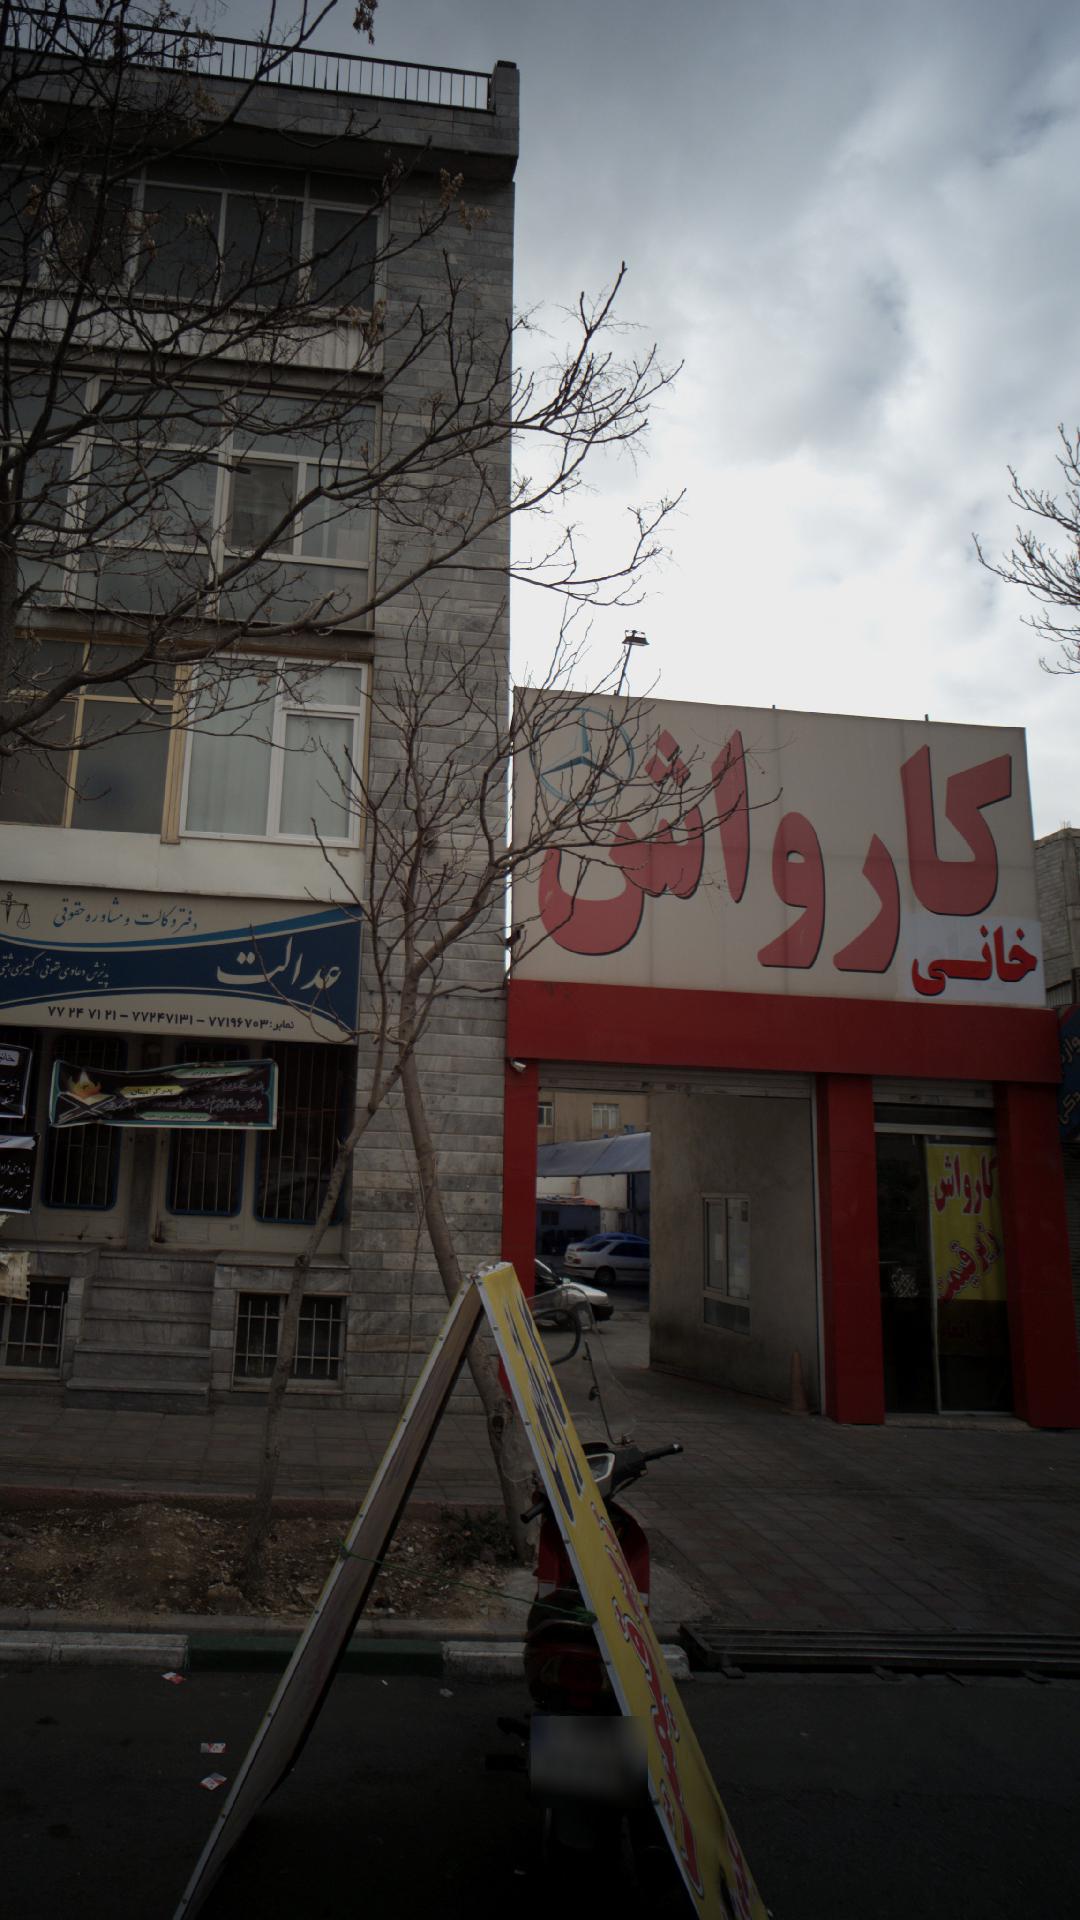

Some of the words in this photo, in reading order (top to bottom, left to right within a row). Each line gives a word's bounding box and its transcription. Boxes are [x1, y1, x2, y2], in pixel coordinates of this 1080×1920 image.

[538, 729, 1013, 973] کارواش
[53, 898, 86, 927] حقوقی
[85, 897, 123, 924] مشاوره
[134, 905, 177, 930] وکالت
[172, 908, 198, 935] دفتر
[216, 935, 342, 991] عدالت
[911, 925, 1038, 996] خانی
[935, 1152, 999, 1212] کارواش
[502, 1290, 586, 1525] کارواش
